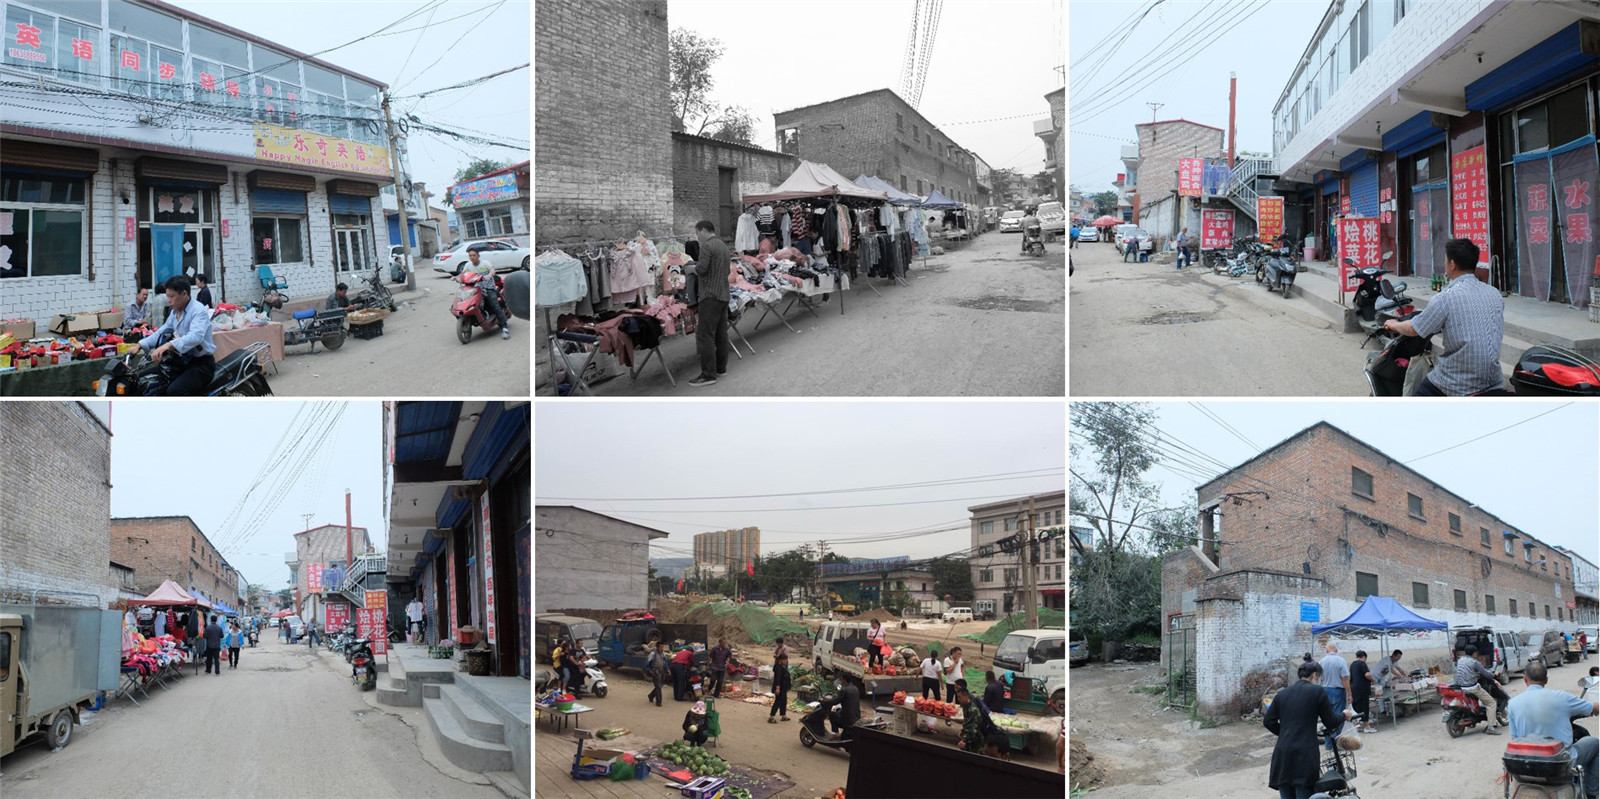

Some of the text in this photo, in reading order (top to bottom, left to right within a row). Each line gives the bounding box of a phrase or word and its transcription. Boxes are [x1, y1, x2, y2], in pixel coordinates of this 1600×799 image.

[16, 23, 240, 99] 英语同步辅导
[261, 149, 292, 162] Happy
[295, 155, 319, 165] Magic
[321, 159, 349, 169] English
[294, 133, 367, 161] 乐奇英语
[1181, 159, 1190, 189] 大盘鸡
[1192, 159, 1201, 189] 各种面食
[1527, 183, 1549, 244] 蔬菜
[1565, 178, 1592, 244] 水果
[1363, 220, 1380, 272] 桃花
[359, 610, 372, 644] 烩菜
[372, 609, 386, 653] 桃花面
